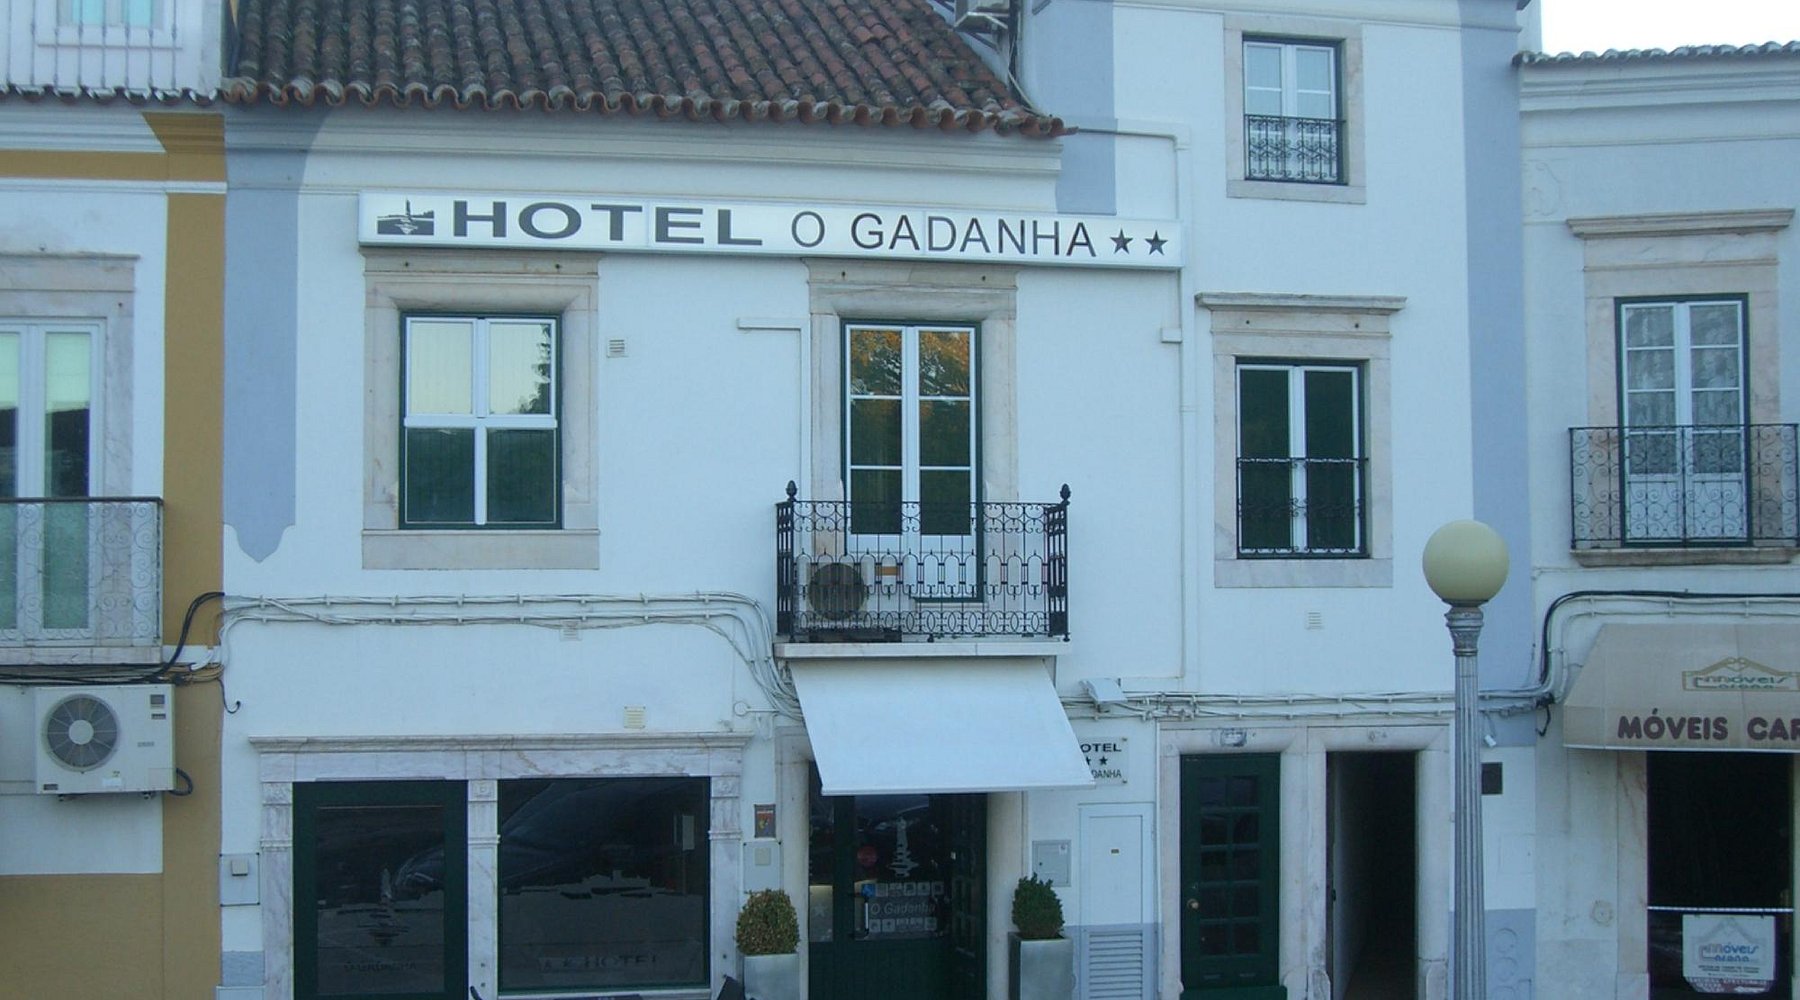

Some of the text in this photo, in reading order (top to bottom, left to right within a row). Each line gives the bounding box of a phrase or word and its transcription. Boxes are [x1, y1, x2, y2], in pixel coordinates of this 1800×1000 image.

[453, 200, 1097, 257] HOTEL O GADANHA
[1617, 708, 1729, 740] MÓVEIS
[1080, 743, 1122, 753] OTEL
[1091, 769, 1122, 779] DANHA
